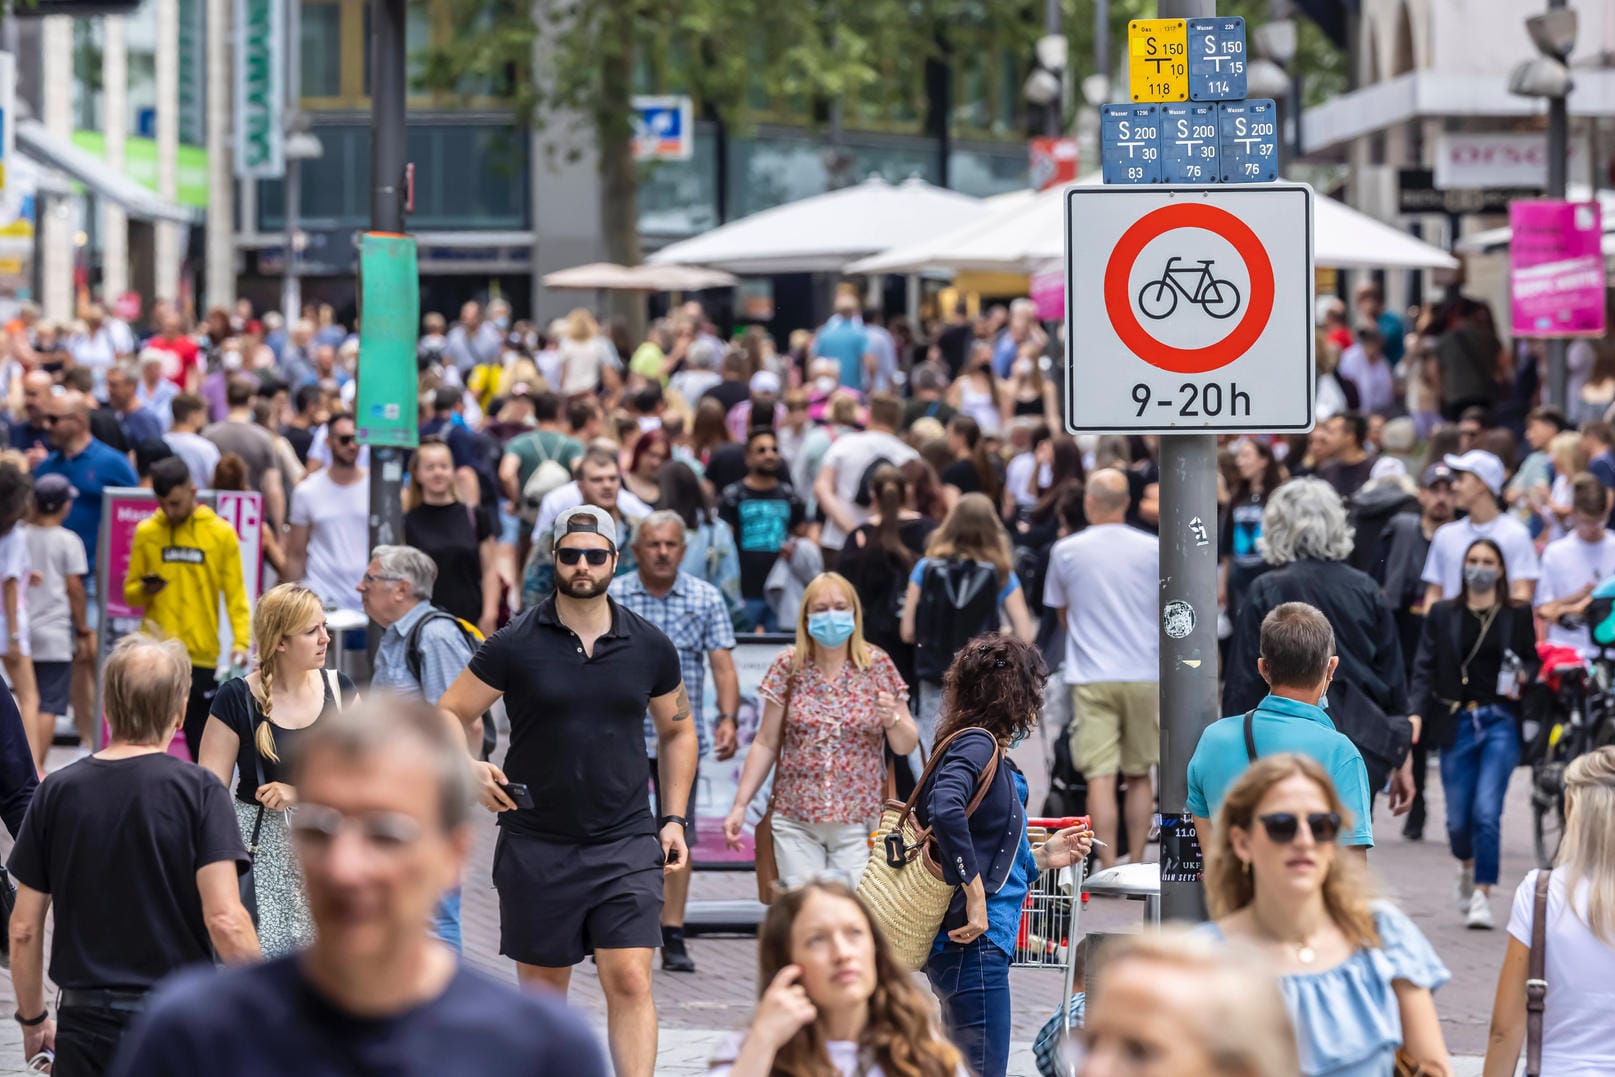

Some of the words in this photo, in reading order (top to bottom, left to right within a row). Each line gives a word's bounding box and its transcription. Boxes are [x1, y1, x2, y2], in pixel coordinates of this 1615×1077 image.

[1146, 37, 1156, 55] S
[1162, 43, 1184, 55] 150
[1204, 35, 1216, 54] S
[1221, 41, 1242, 53] 150
[1119, 121, 1130, 140] S
[1134, 127, 1156, 140] 200
[1178, 119, 1188, 138] S
[1192, 126, 1214, 138] 200
[1236, 117, 1246, 136] S
[1251, 124, 1273, 136] 200
